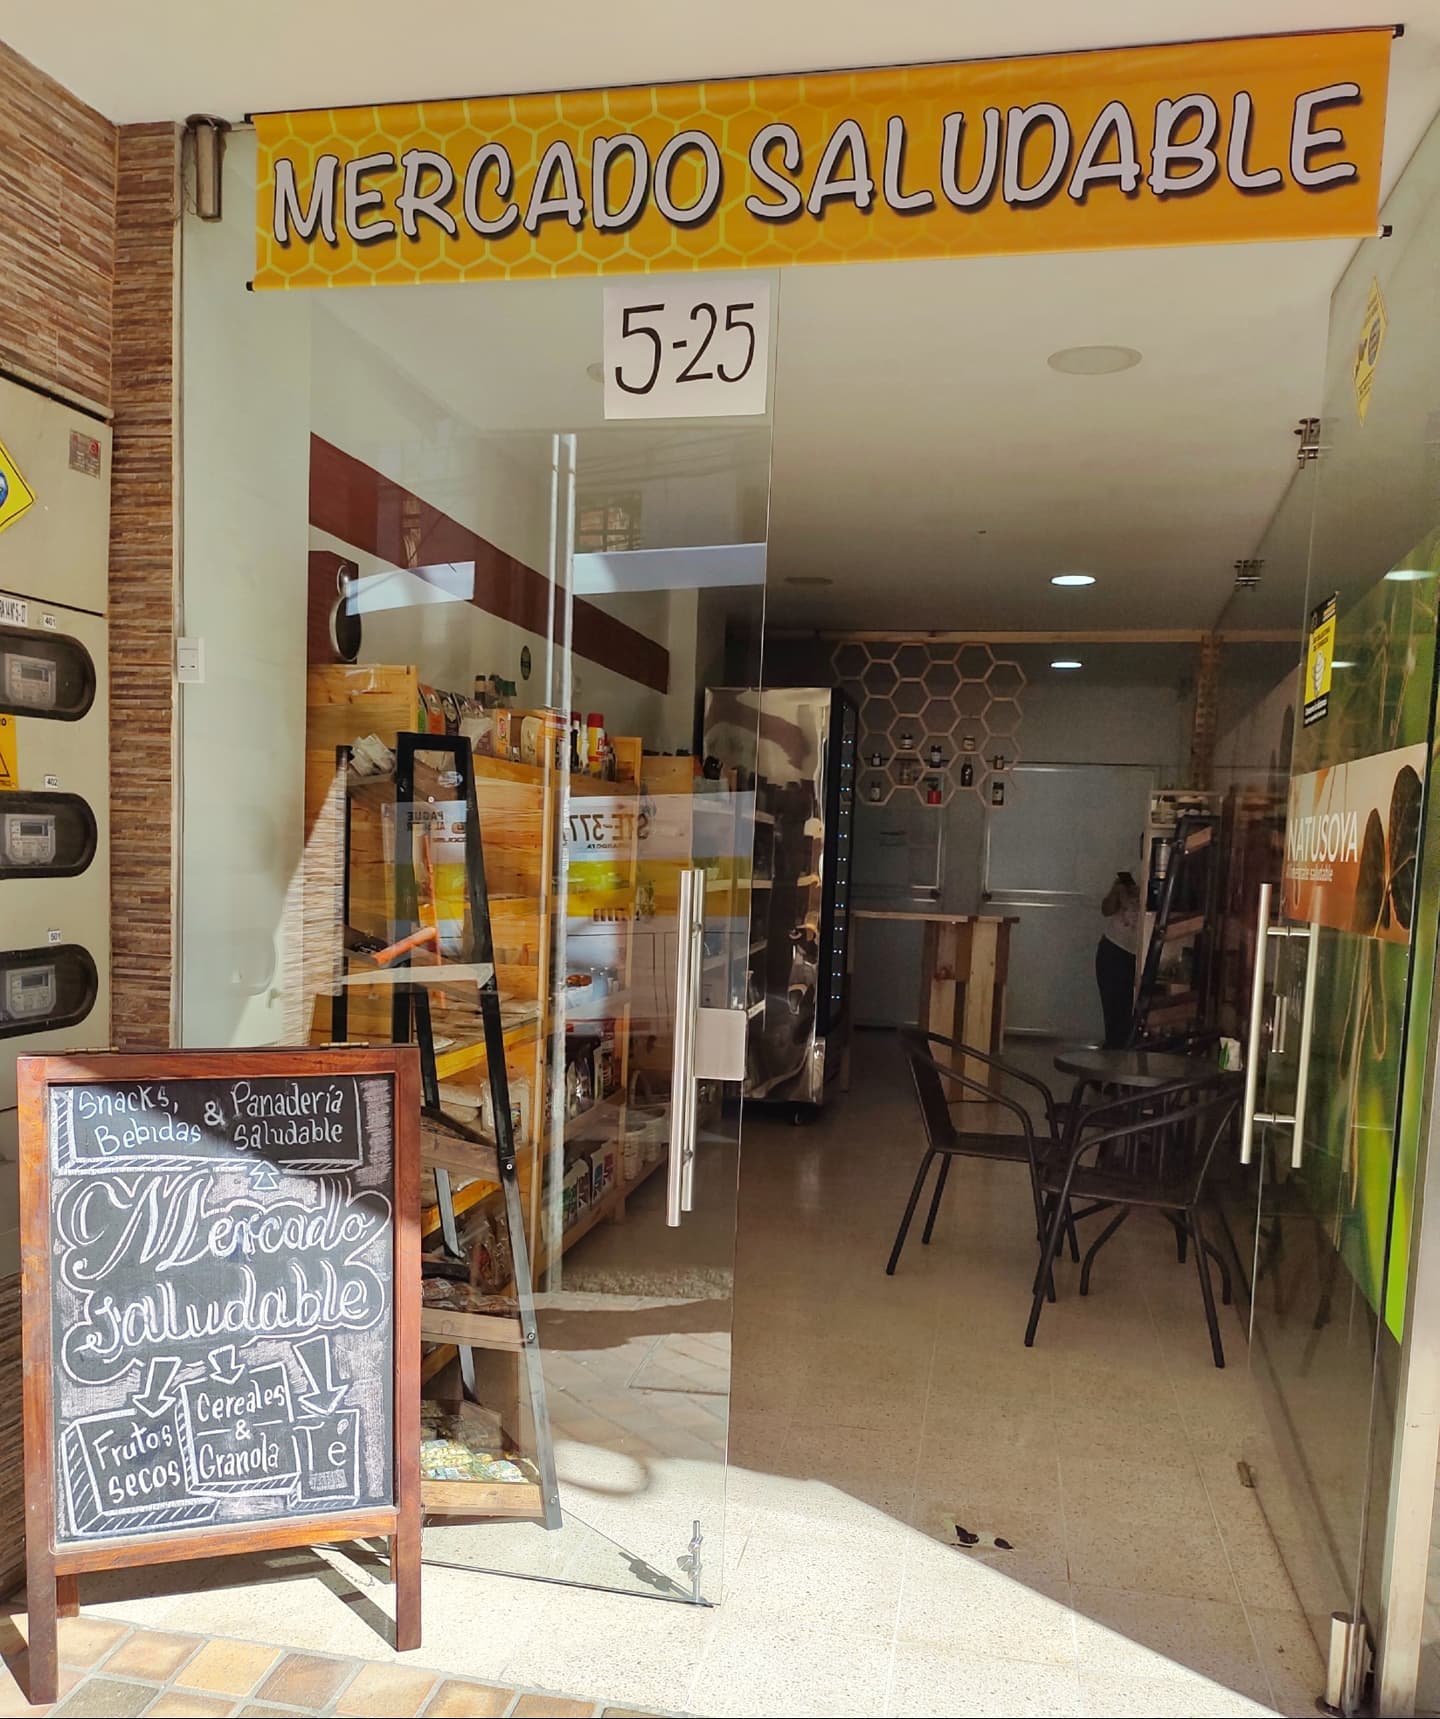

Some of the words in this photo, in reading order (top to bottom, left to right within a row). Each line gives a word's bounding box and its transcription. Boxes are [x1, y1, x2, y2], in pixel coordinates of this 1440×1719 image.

[272, 130, 724, 249] MERCADO
[745, 81, 1362, 223] SALUDABLE
[615, 303, 755, 394] 5-25
[1287, 812, 1358, 863] NATUSOYA
[50, 932, 61, 941] 501
[78, 1085, 179, 1117] Snacks,
[204, 1101, 224, 1126] &
[231, 1081, 344, 1118] Panadería
[95, 1113, 202, 1155] Bebidas
[72, 1170, 376, 1280] Mercado
[76, 1258, 370, 1362] Saludable
[197, 1380, 286, 1422] Cereales
[92, 1423, 173, 1470] Frutos
[234, 1420, 252, 1440] &
[293, 1419, 349, 1471] Té
[198, 1432, 280, 1480] Granola
